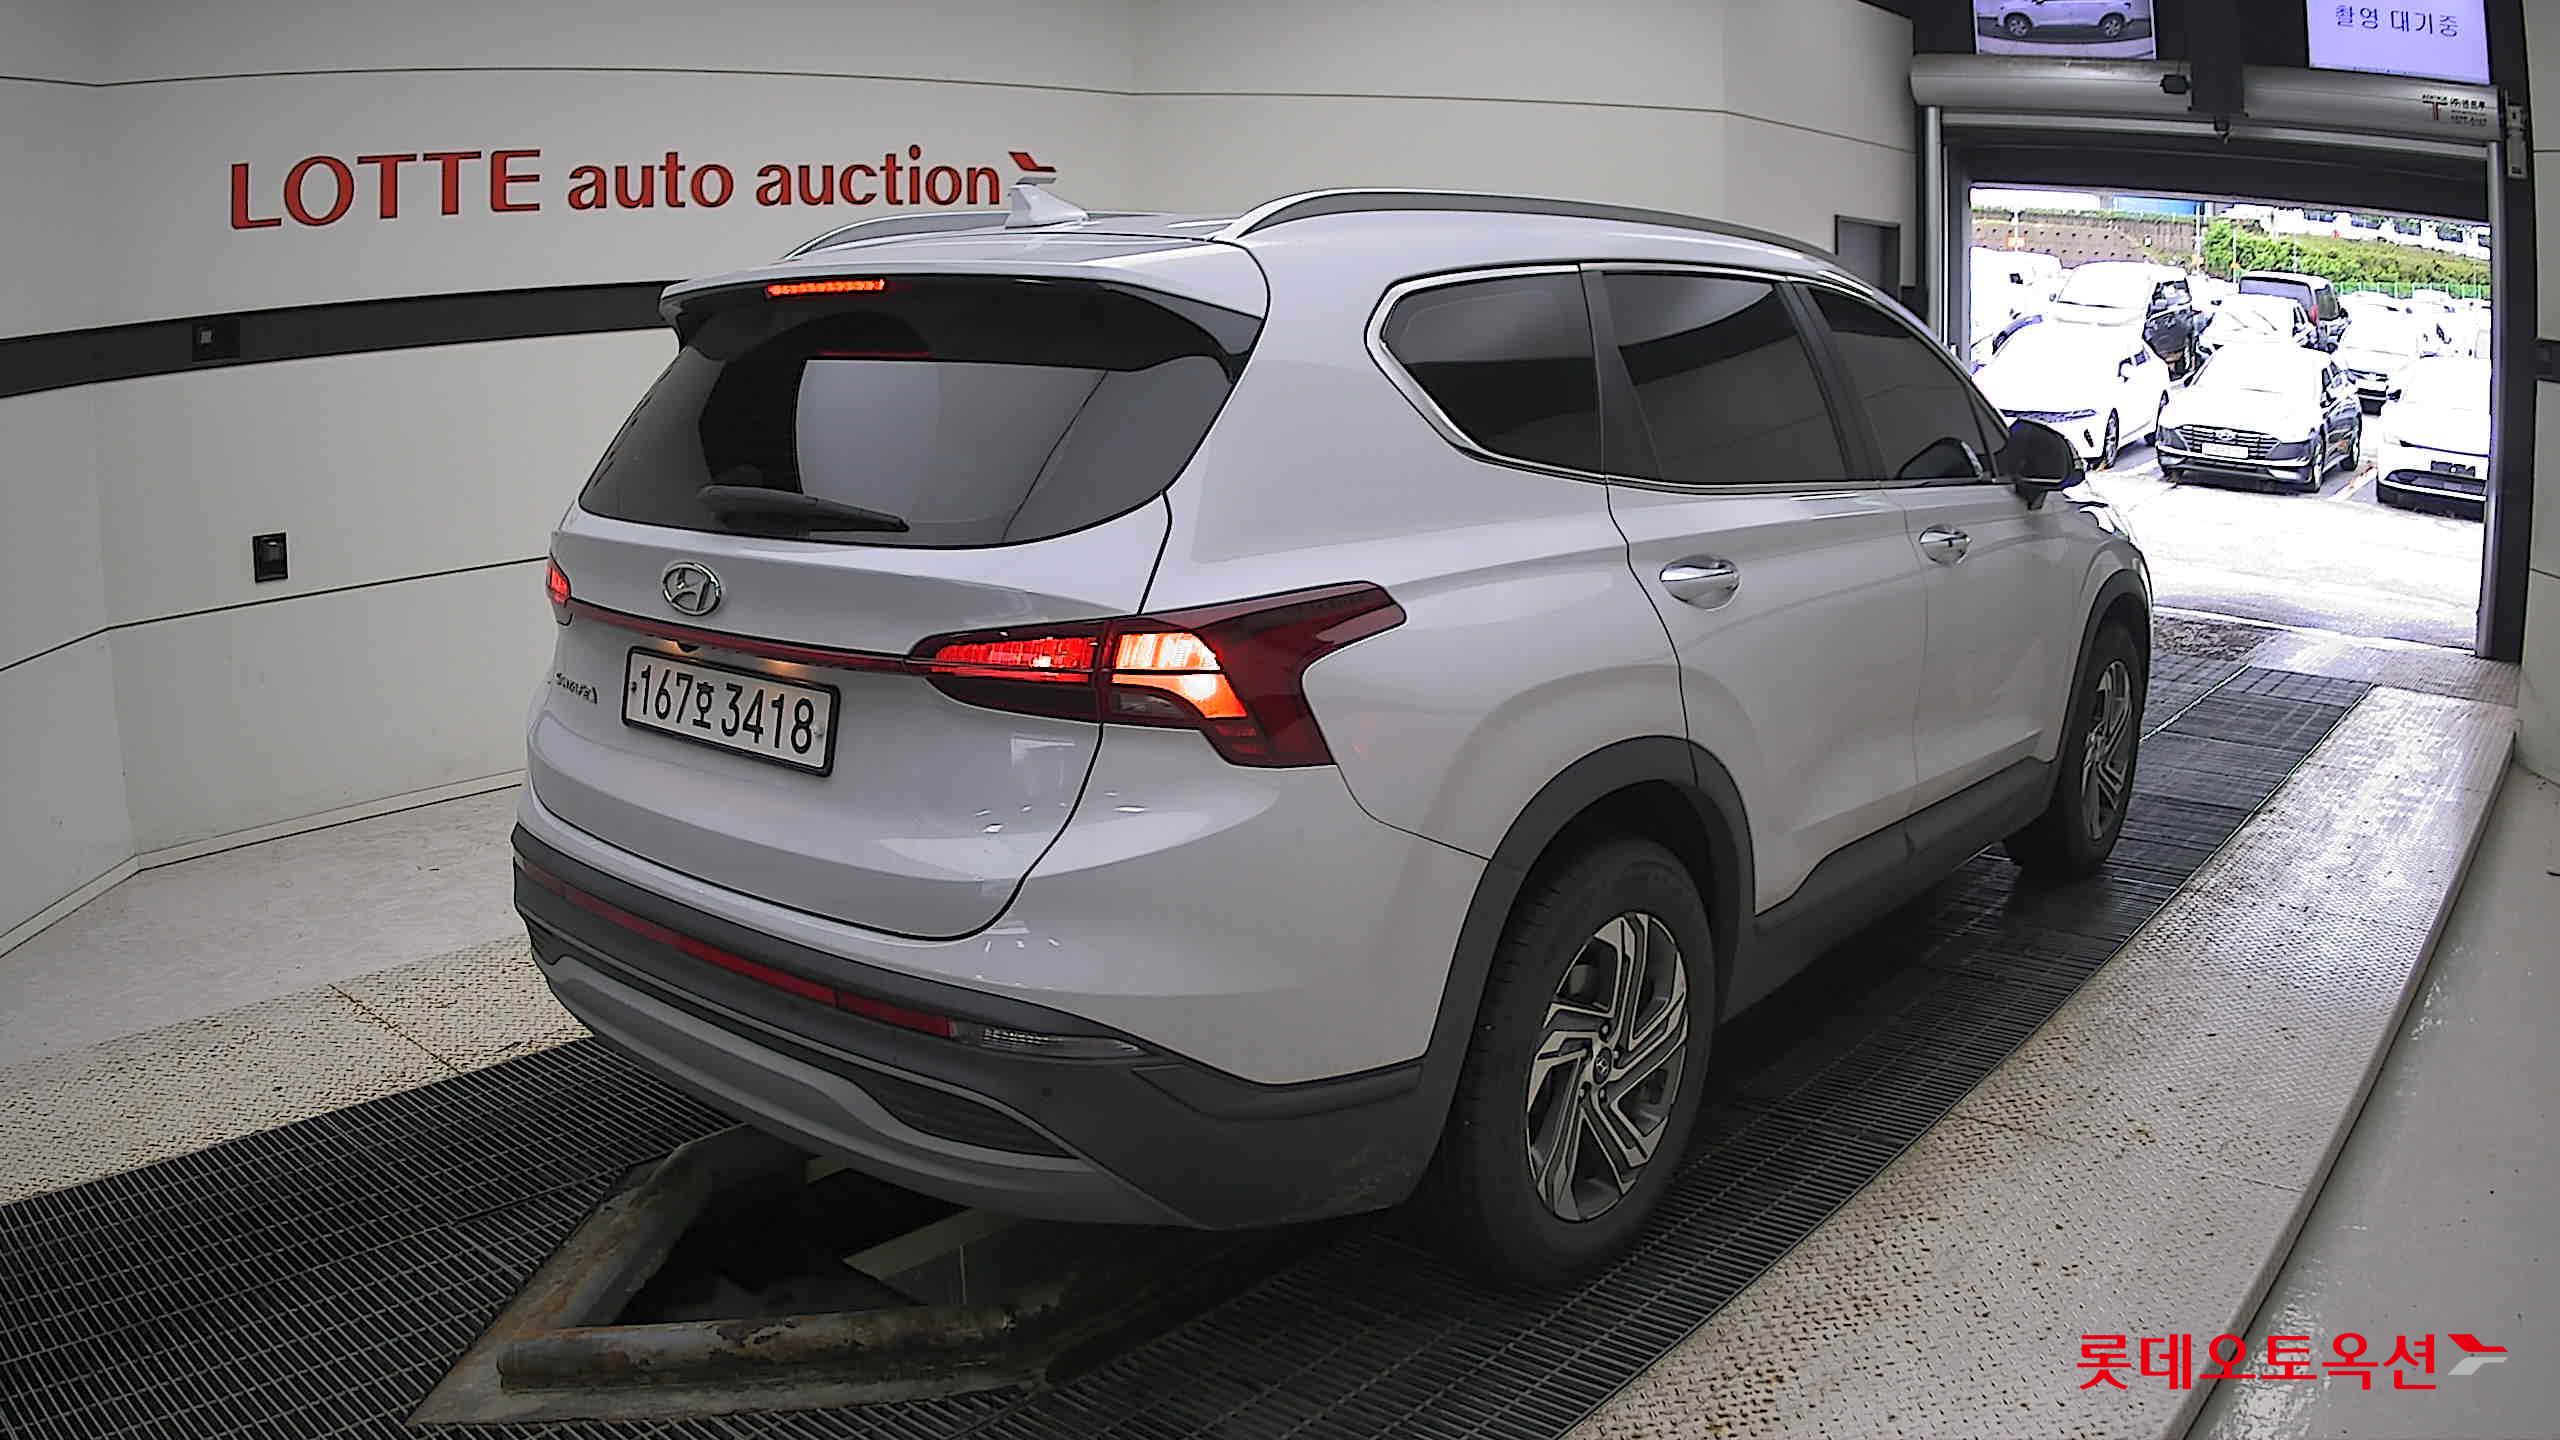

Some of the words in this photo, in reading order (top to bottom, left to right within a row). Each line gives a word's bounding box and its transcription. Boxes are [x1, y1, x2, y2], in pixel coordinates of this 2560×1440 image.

[2390, 10, 2458, 38] 대기중
[230, 149, 541, 230] LOTTE
[567, 151, 735, 209] auto
[756, 145, 1001, 206] auction
